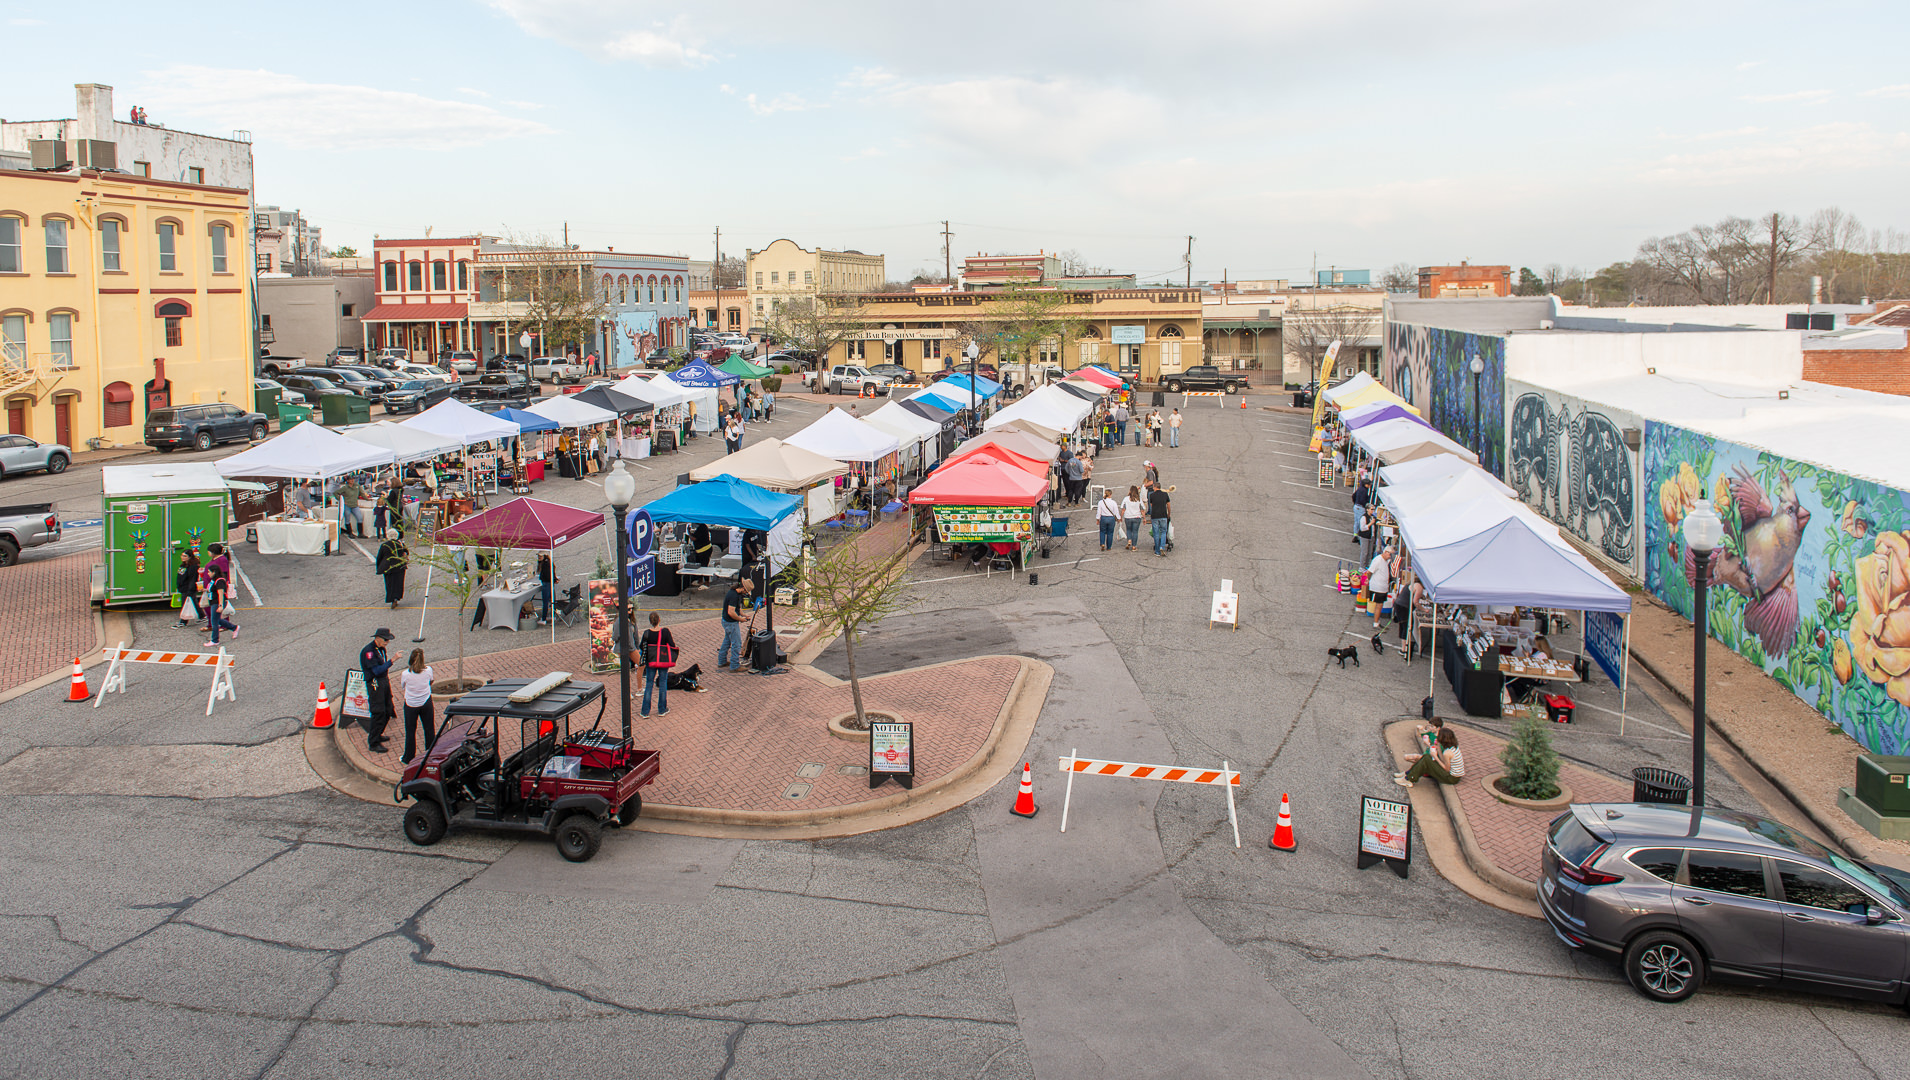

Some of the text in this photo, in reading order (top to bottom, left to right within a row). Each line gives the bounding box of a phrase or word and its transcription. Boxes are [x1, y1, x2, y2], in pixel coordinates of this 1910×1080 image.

[636, 519, 648, 550] P
[634, 571, 652, 590] Lot E
[1366, 799, 1406, 814] NOTICE
